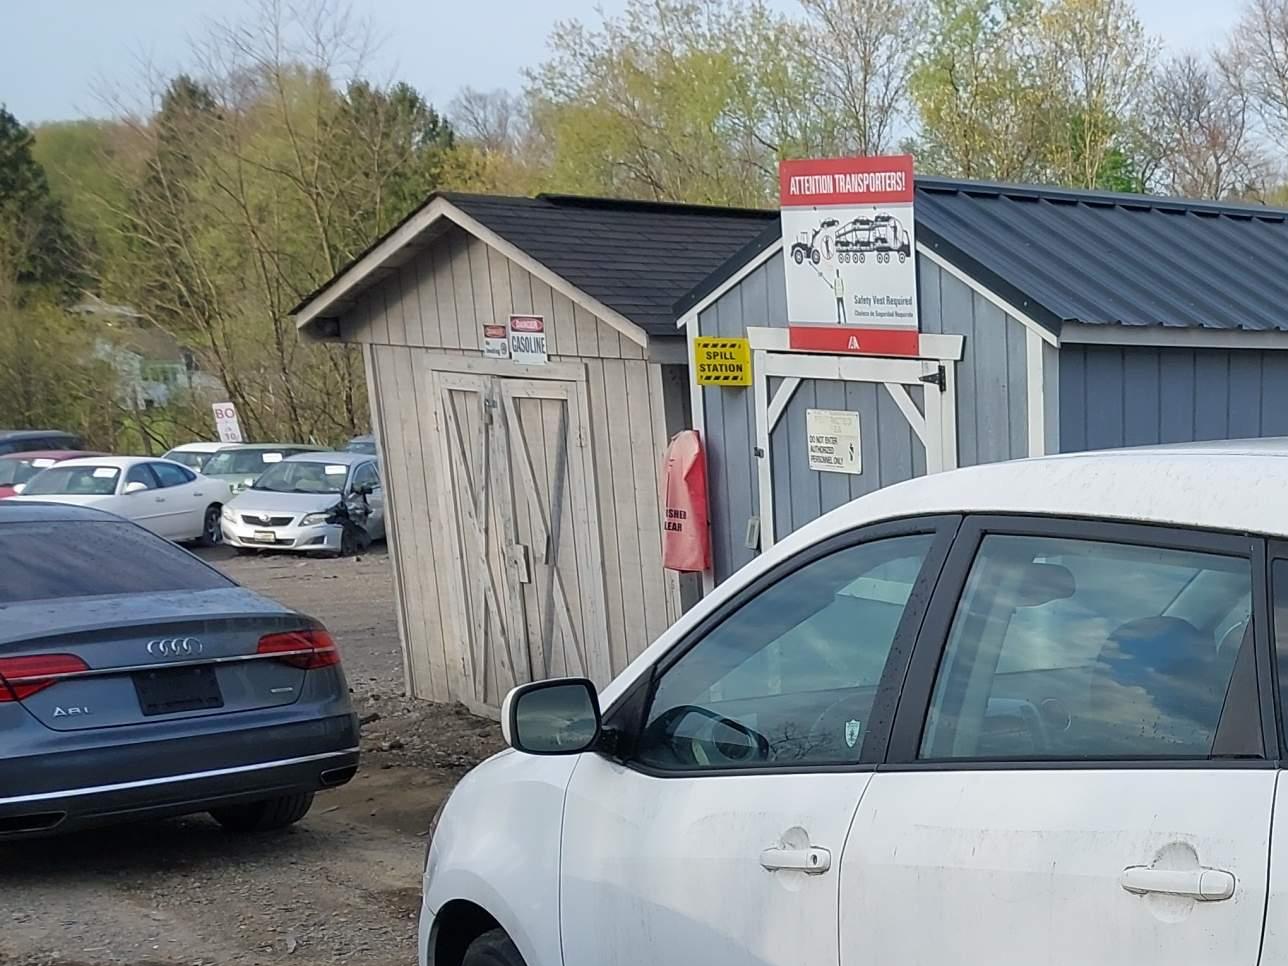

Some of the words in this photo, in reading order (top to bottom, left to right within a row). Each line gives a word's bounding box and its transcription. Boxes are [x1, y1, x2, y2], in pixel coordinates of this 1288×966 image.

[790, 175, 833, 195] ATTENTION
[834, 171, 905, 193] TRANSPORTERS!
[511, 335, 545, 354] GASOLINE
[705, 350, 736, 361] SPILL
[699, 363, 743, 373] STATION
